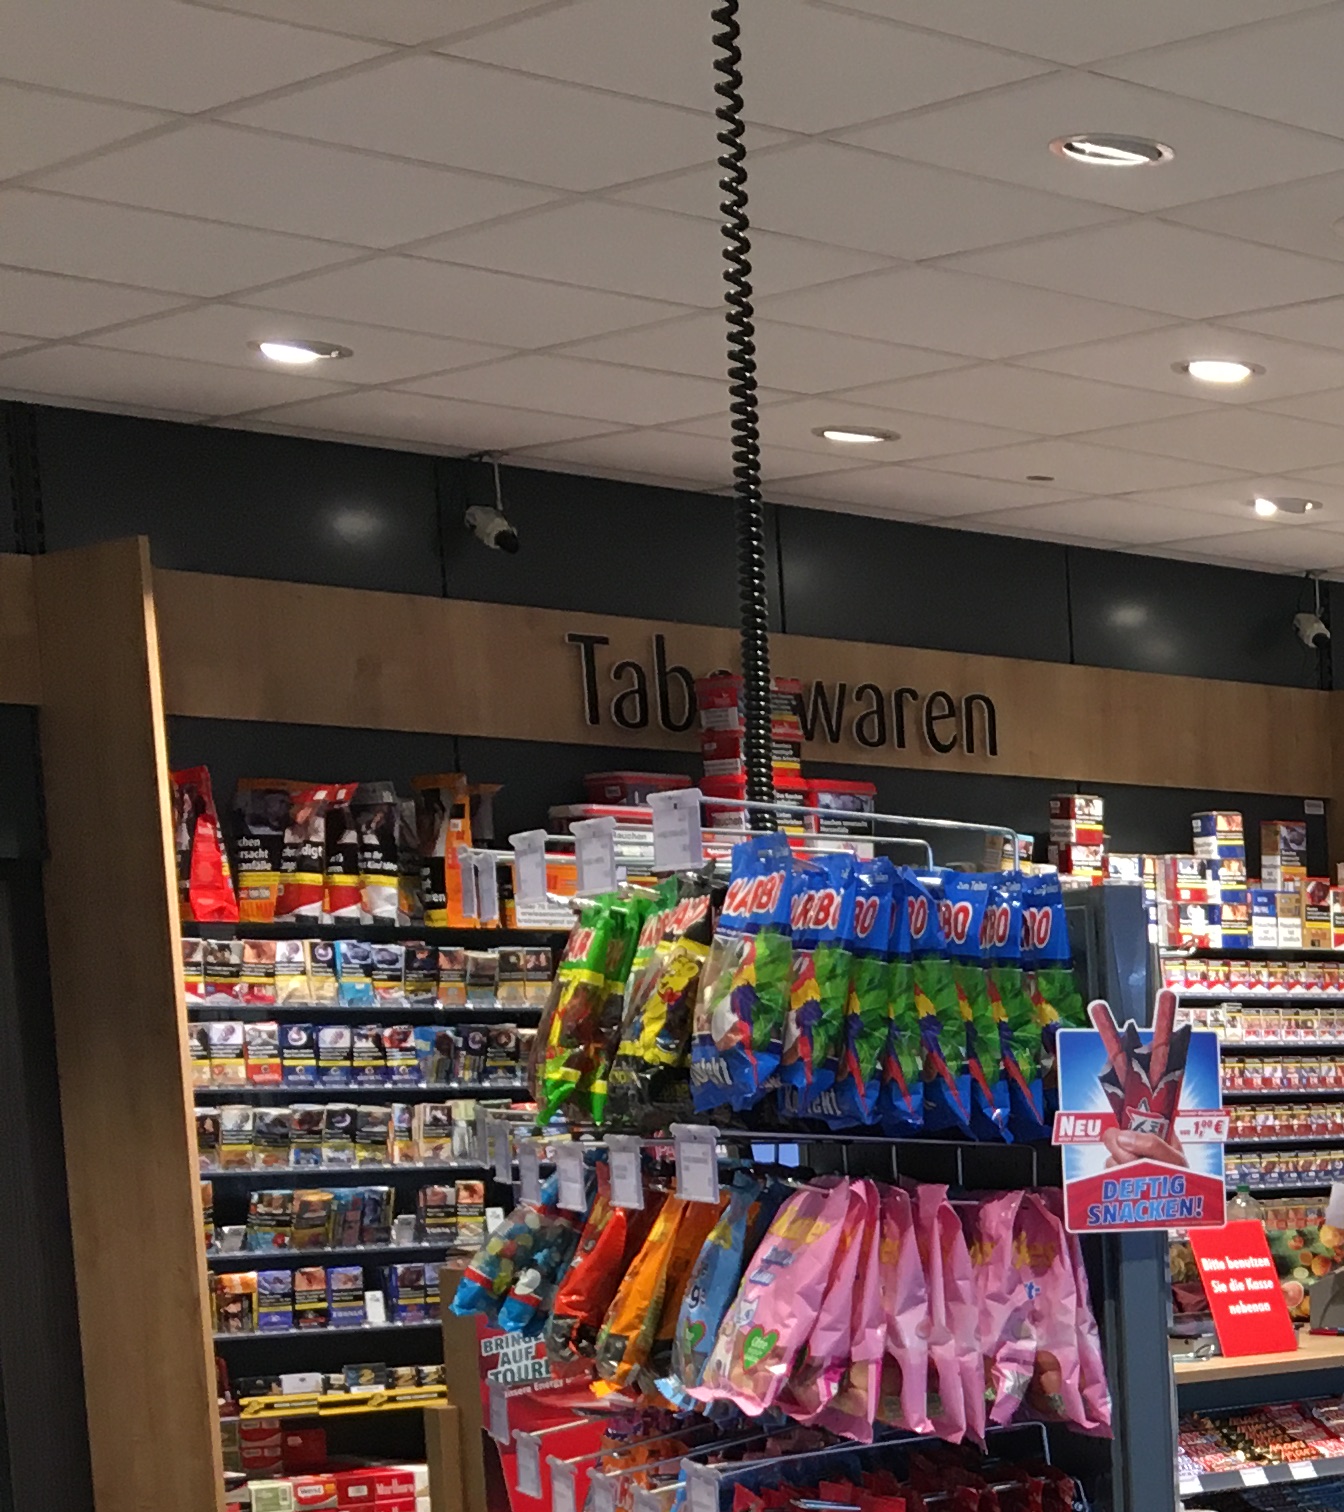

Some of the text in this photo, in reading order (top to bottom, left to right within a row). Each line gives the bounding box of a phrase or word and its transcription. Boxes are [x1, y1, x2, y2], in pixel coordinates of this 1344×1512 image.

[564, 633, 998, 757] Tabwaren
[238, 849, 269, 859] rsacht
[1058, 1115, 1101, 1137] NEU
[1103, 1175, 1186, 1201] DEFTIG
[1087, 1196, 1204, 1226] SNACKEN!
[1201, 1255, 1271, 1272] Bitte benutzen
[1211, 1277, 1274, 1293] Sie die Kasse
[500, 1342, 536, 1367] AUF
[490, 1358, 553, 1387] TOUR
